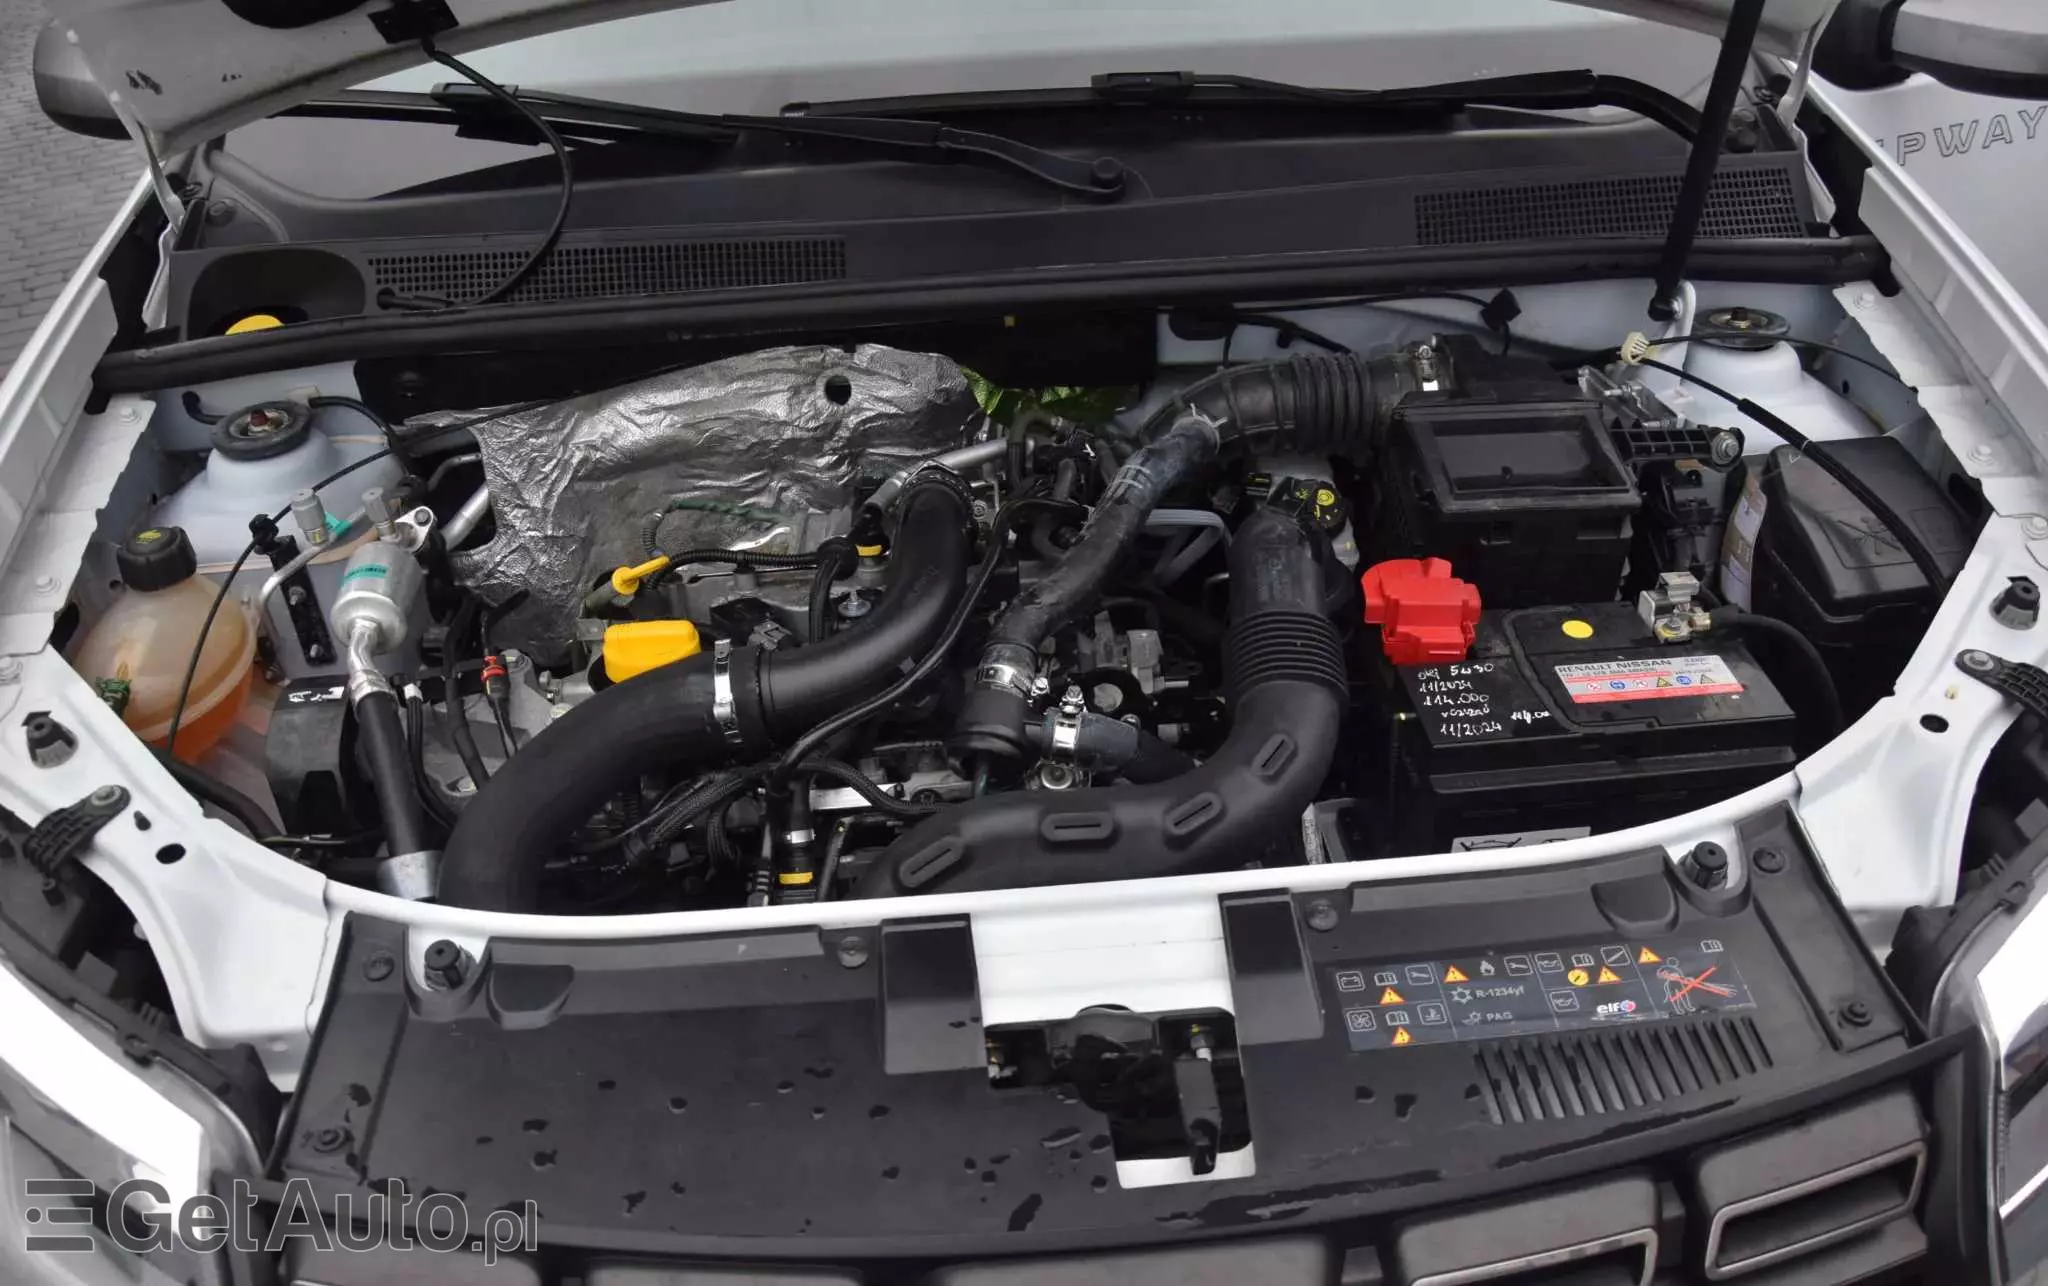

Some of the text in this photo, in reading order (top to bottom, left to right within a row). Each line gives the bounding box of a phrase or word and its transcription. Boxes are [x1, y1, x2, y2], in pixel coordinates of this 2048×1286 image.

[1558, 663, 1614, 673] RENAULT
[1616, 659, 1672, 669] NISSAN
[1440, 721, 1502, 738] 11/2024
[1475, 985, 1525, 999] R-1234yf
[1596, 1000, 1621, 1014] elf
[1486, 1012, 1513, 1023] PAG
